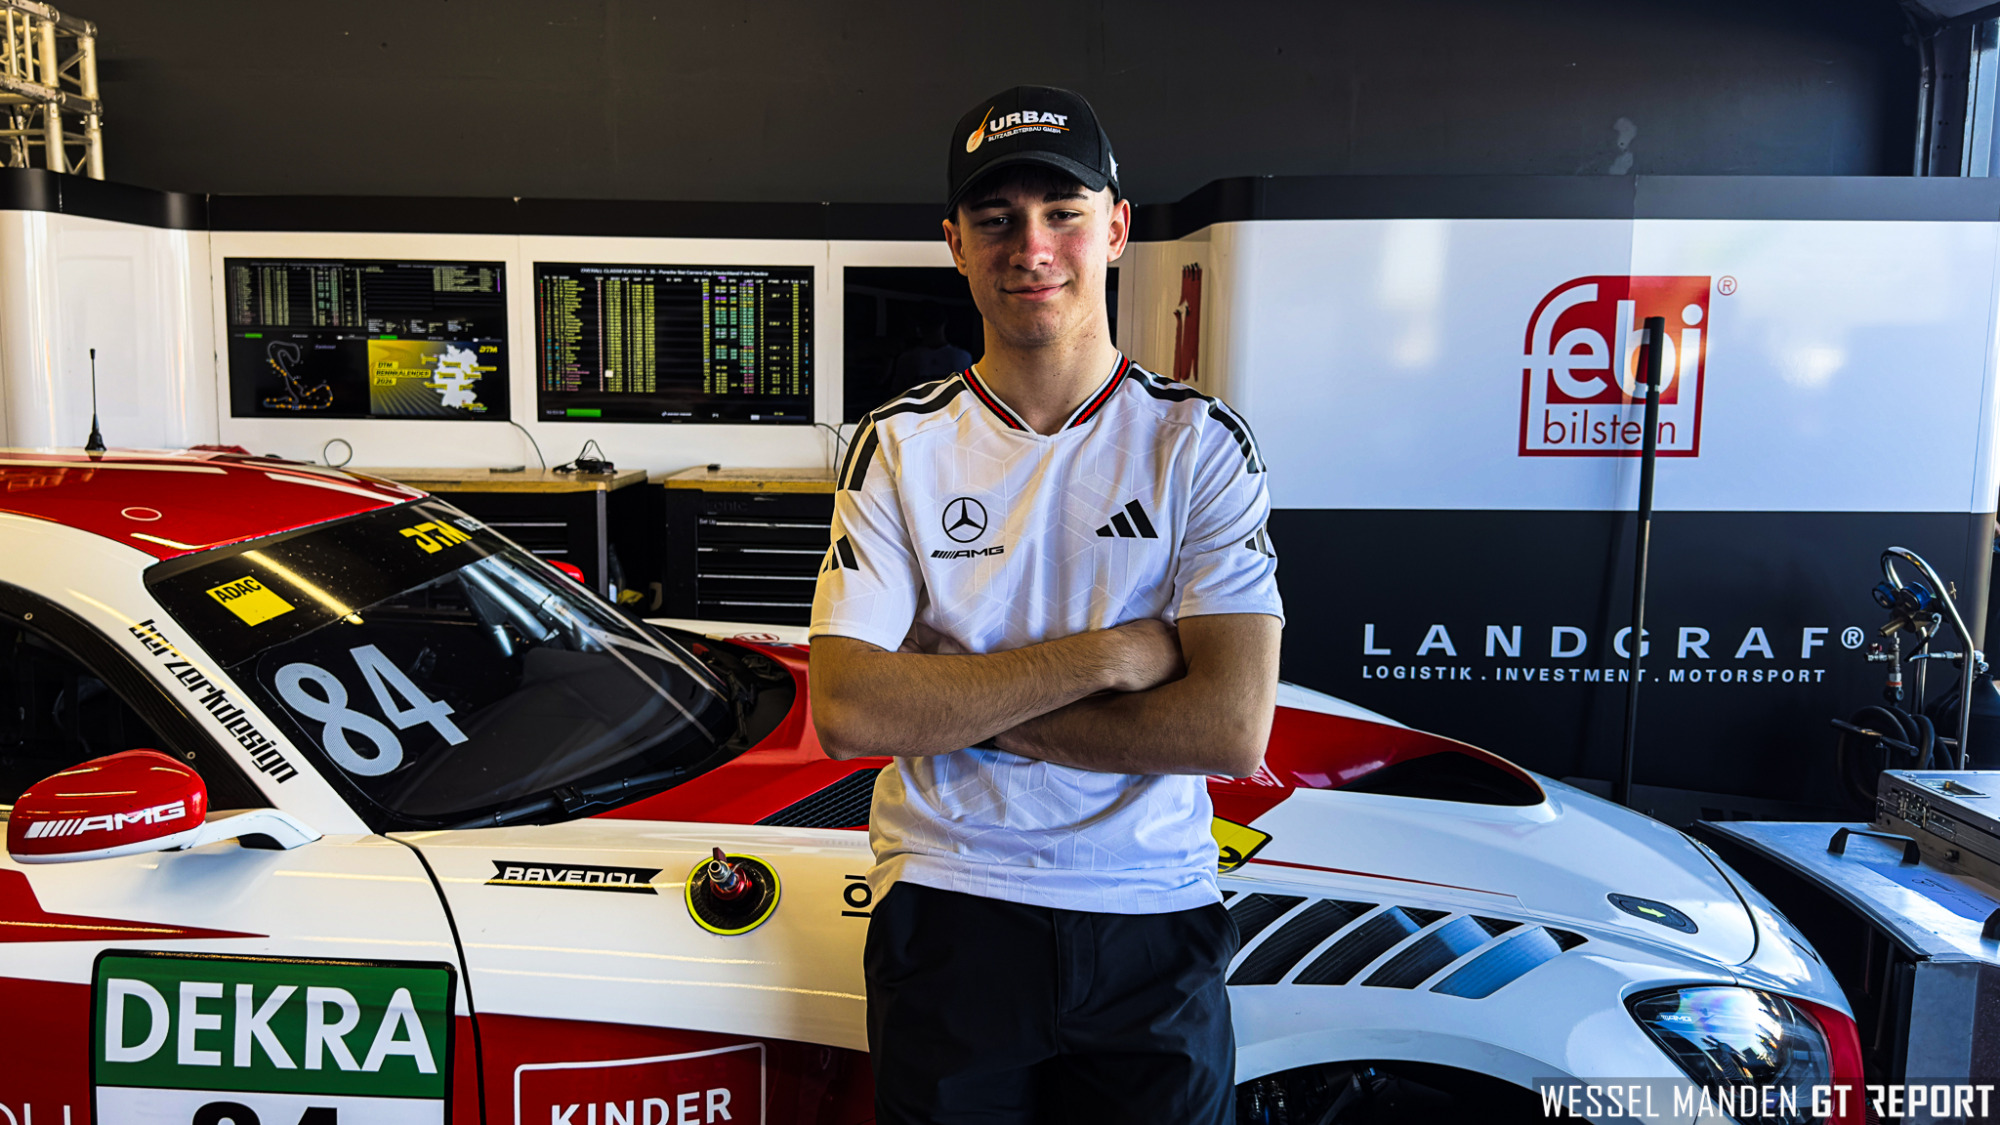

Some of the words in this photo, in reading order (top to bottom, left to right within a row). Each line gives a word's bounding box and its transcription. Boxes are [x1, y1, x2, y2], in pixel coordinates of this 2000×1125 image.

[989, 110, 1068, 132] URBAT
[1523, 280, 1704, 400] febi
[1543, 408, 1677, 445] bilsten
[399, 519, 473, 554] DTM
[952, 545, 1004, 560] AMG
[213, 578, 262, 603] ADAC
[1362, 665, 1473, 681] LOGISTIK
[1496, 667, 1646, 683] INVESTMENT
[1669, 669, 1826, 683] MOTORSPORT
[128, 619, 299, 784] berzerkdesign
[274, 643, 470, 777] 84
[74, 800, 187, 836] AMG
[502, 866, 645, 888] RAVENOL
[104, 977, 439, 1075] DEKRA
[551, 1087, 733, 1125] KINDER
